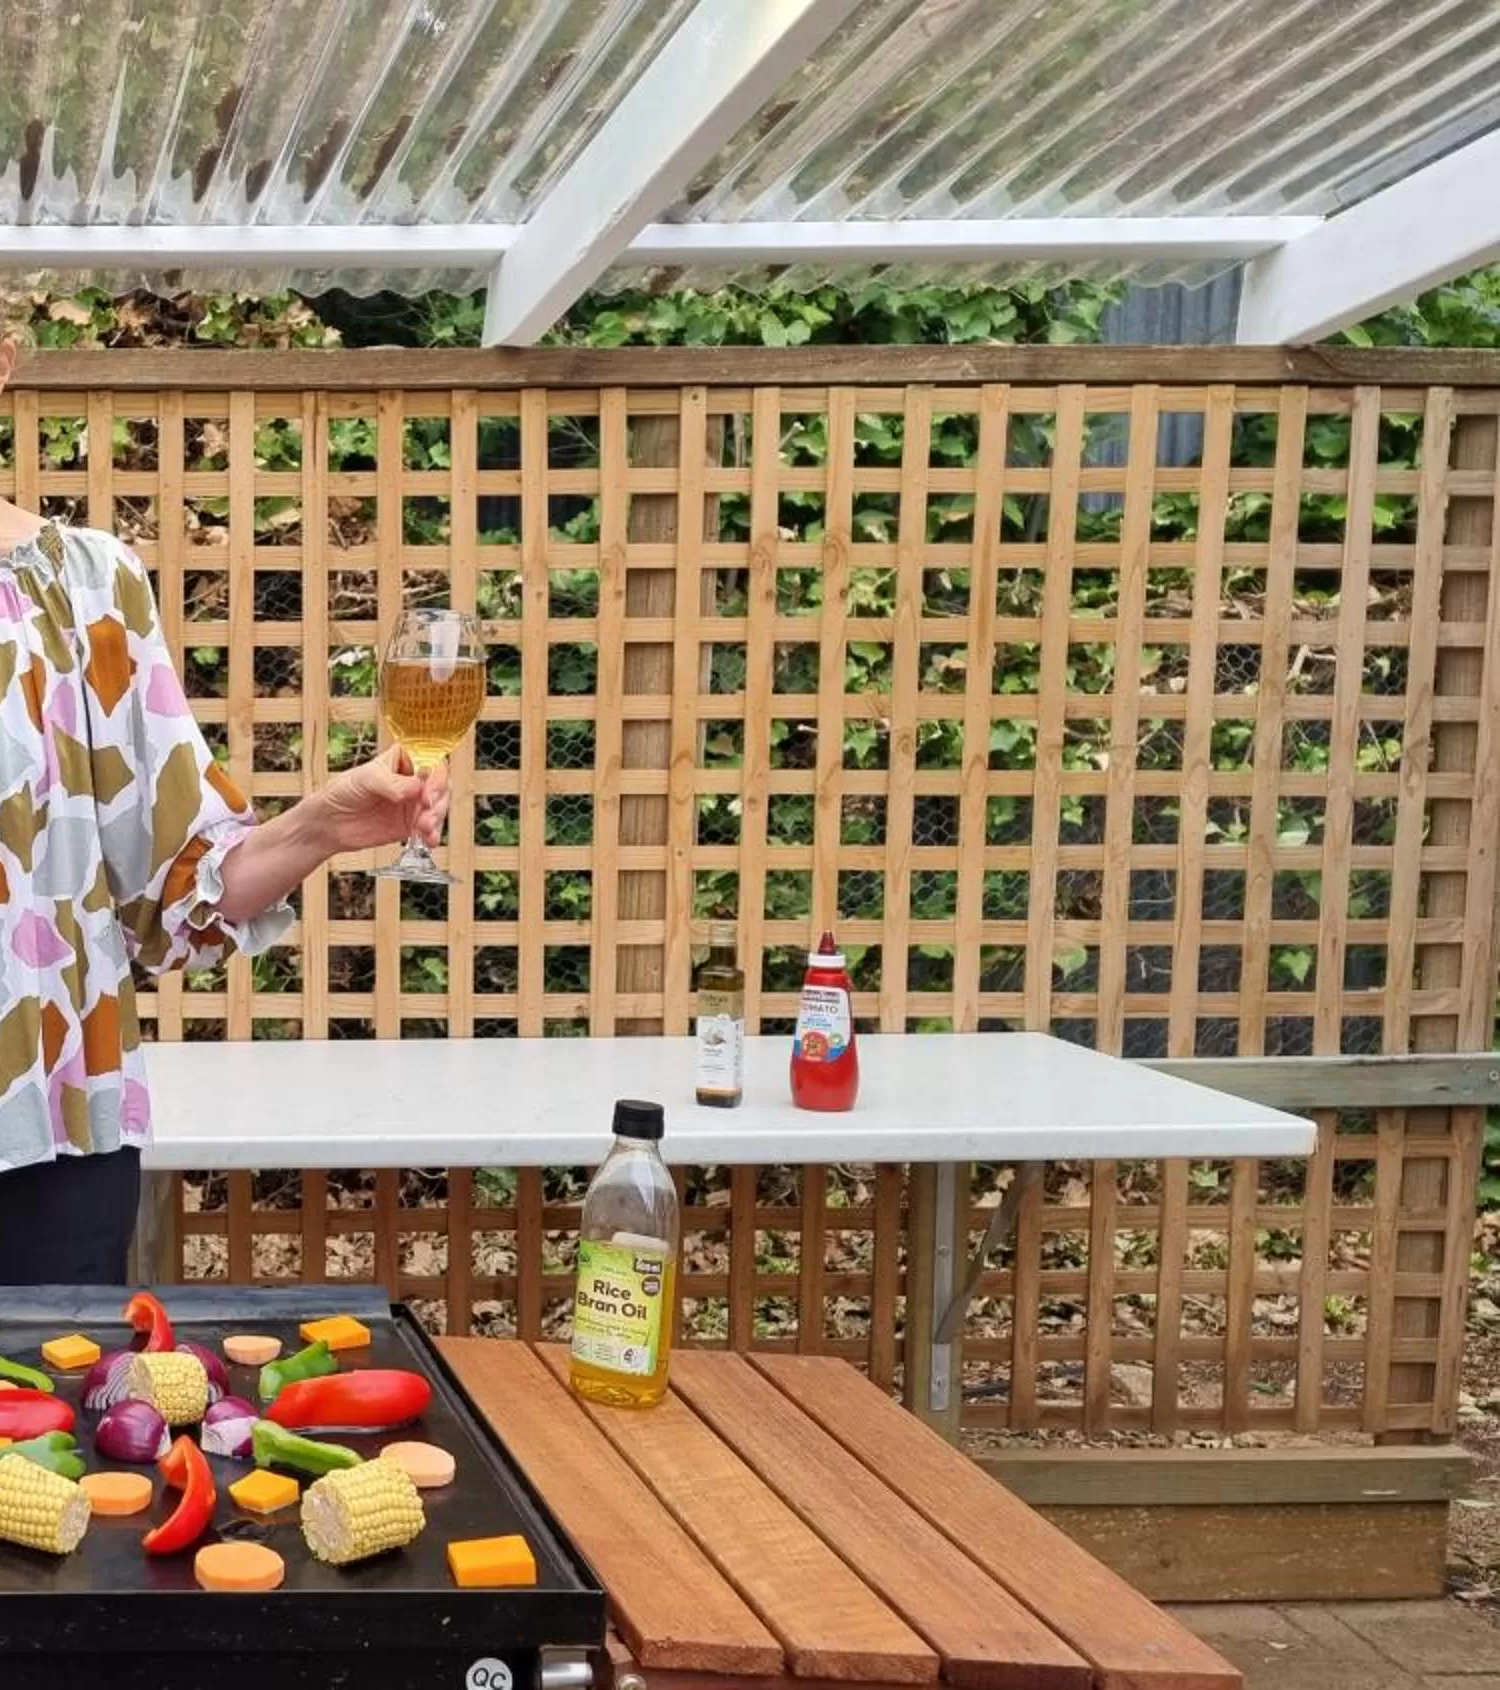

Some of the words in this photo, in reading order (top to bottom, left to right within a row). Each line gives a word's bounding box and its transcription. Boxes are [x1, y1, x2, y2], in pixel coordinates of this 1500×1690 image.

[593, 1279, 632, 1301] Rice
[577, 1291, 617, 1315] Bran
[621, 1303, 647, 1321] Oil
[472, 1667, 507, 1690] QC
